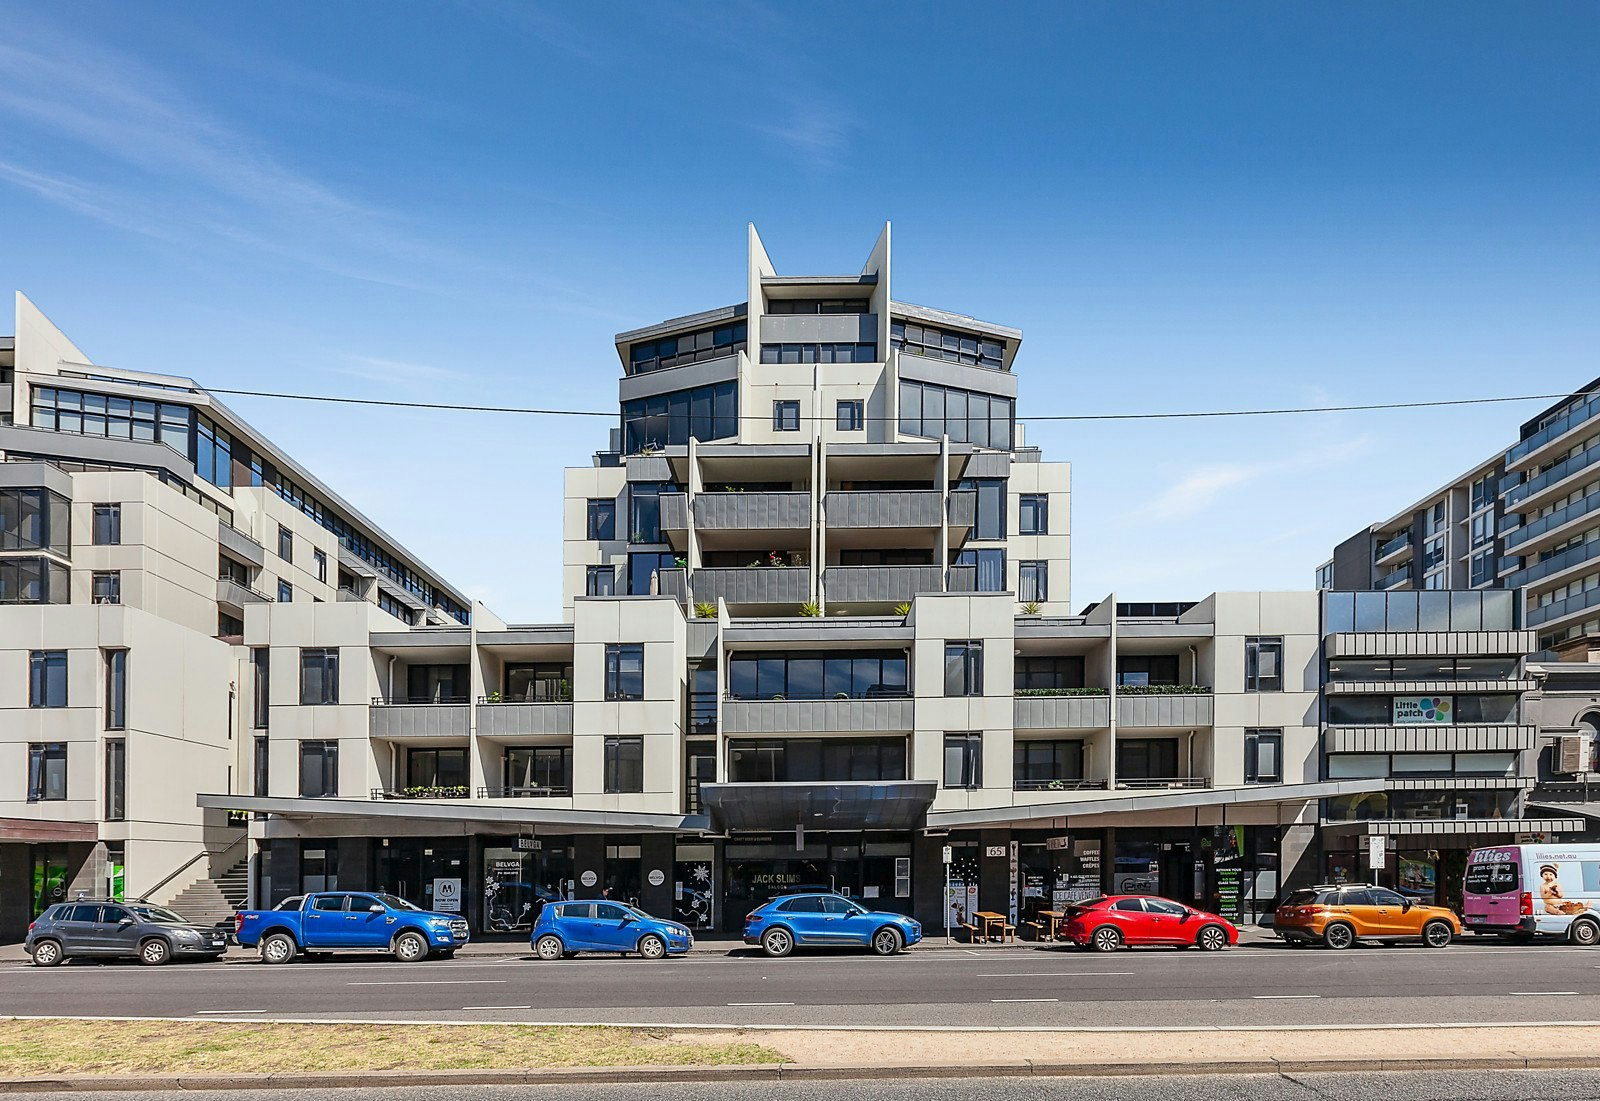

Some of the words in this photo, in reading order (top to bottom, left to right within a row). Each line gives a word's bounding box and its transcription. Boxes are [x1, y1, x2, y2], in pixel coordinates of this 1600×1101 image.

[1395, 701, 1418, 709] Little
[1397, 709, 1423, 719] patch
[990, 847, 1002, 856] 65
[1473, 850, 1511, 863] lilies
[752, 874, 774, 883] JACK
[776, 874, 801, 883] SLIMS
[441, 884, 453, 893] M
